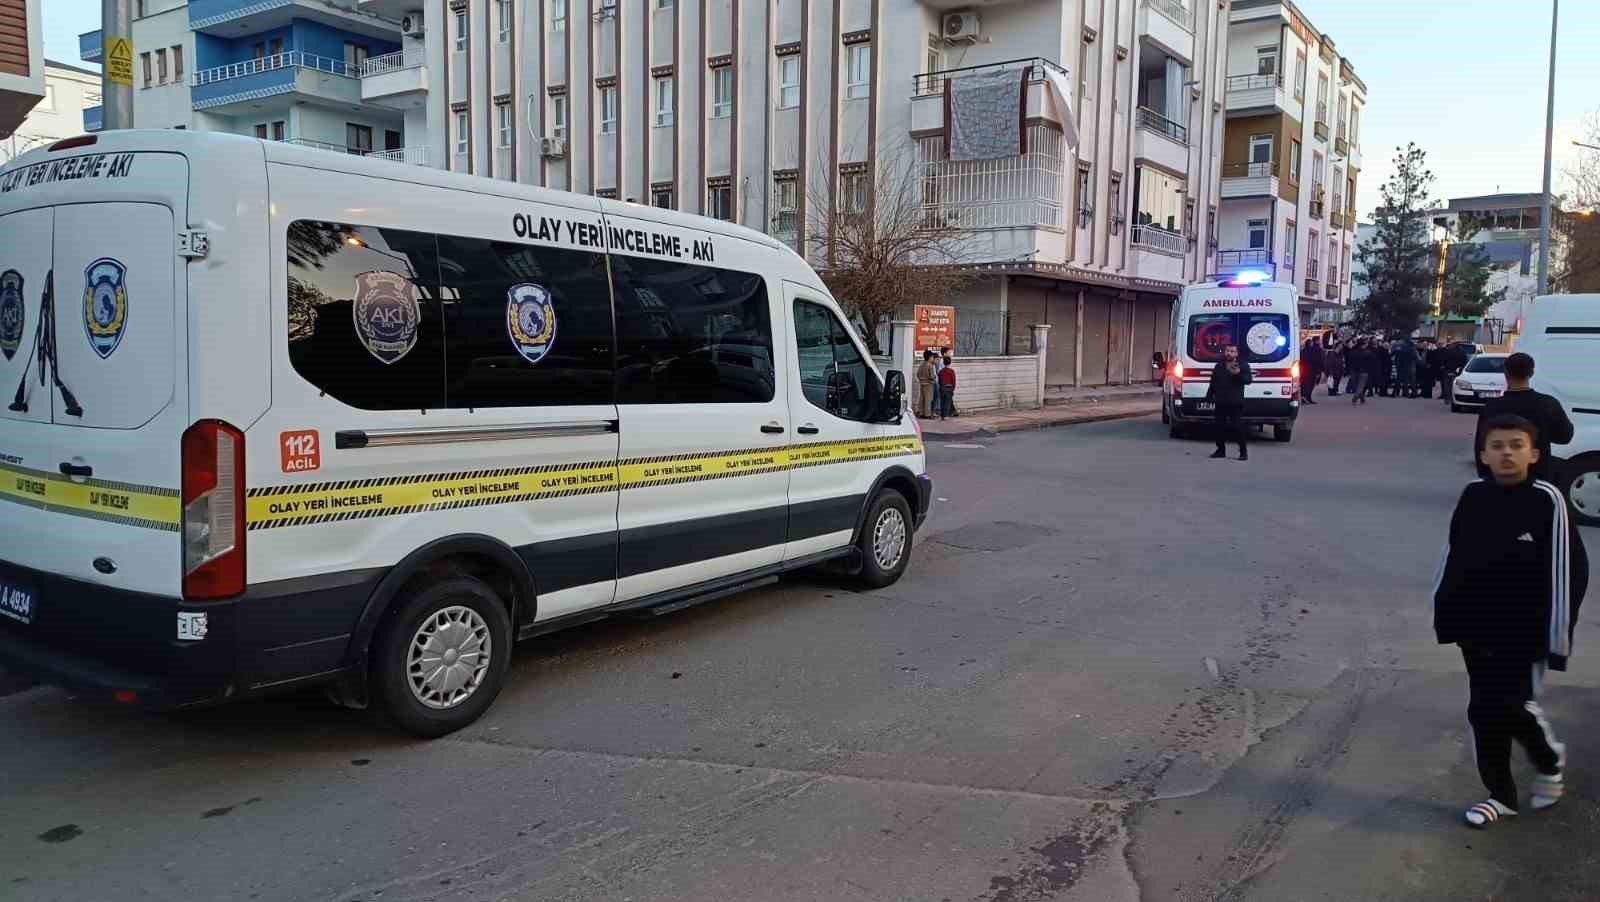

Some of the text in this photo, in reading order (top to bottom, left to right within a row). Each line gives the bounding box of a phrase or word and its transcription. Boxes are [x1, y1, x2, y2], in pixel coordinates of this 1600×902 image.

[513, 212, 561, 242] OLAY
[565, 218, 604, 248] YERİ
[607, 220, 681, 258] İNCELEME
[693, 235, 714, 262] AKİ
[1202, 298, 1273, 308] AMBULANS
[285, 434, 316, 457] 112
[286, 457, 317, 471] ACİL
[644, 467, 659, 477] OLAY
[541, 473, 614, 488] OLAY YERİ İNCELEME
[432, 481, 520, 498] OLAY YERİ İNCELEME
[269, 494, 383, 514] OLAY YERİ İNCELEME
[10, 588, 30, 616] 4934
